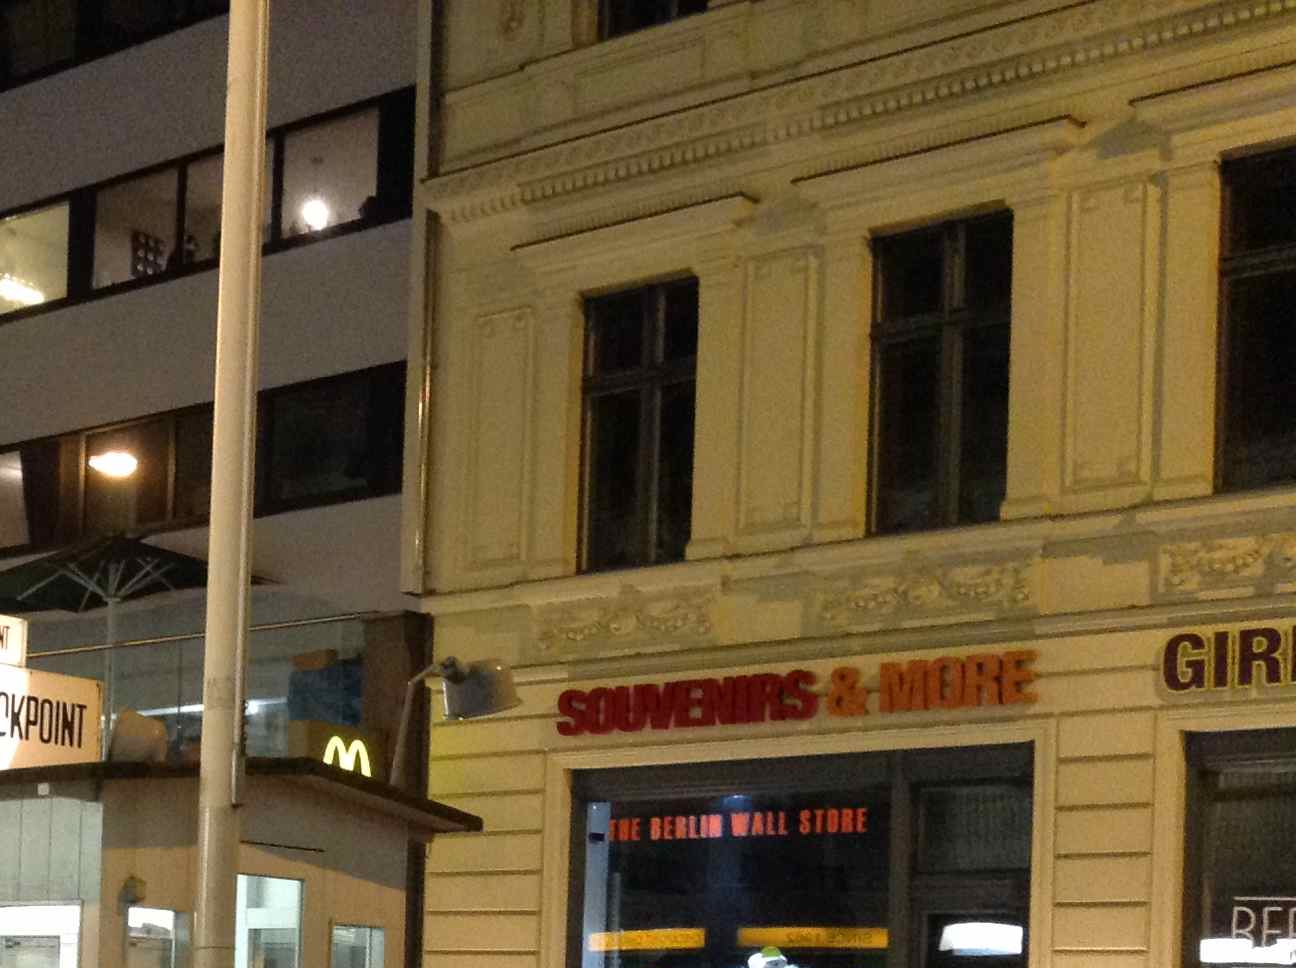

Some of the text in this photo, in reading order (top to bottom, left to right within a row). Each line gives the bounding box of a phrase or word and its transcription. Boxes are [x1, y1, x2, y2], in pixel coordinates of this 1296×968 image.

[1162, 626, 1296, 692] GIR
[557, 650, 1040, 736] SOUVENIRS & MORE
[609, 808, 868, 841] THE BERLIN WALL STORE
